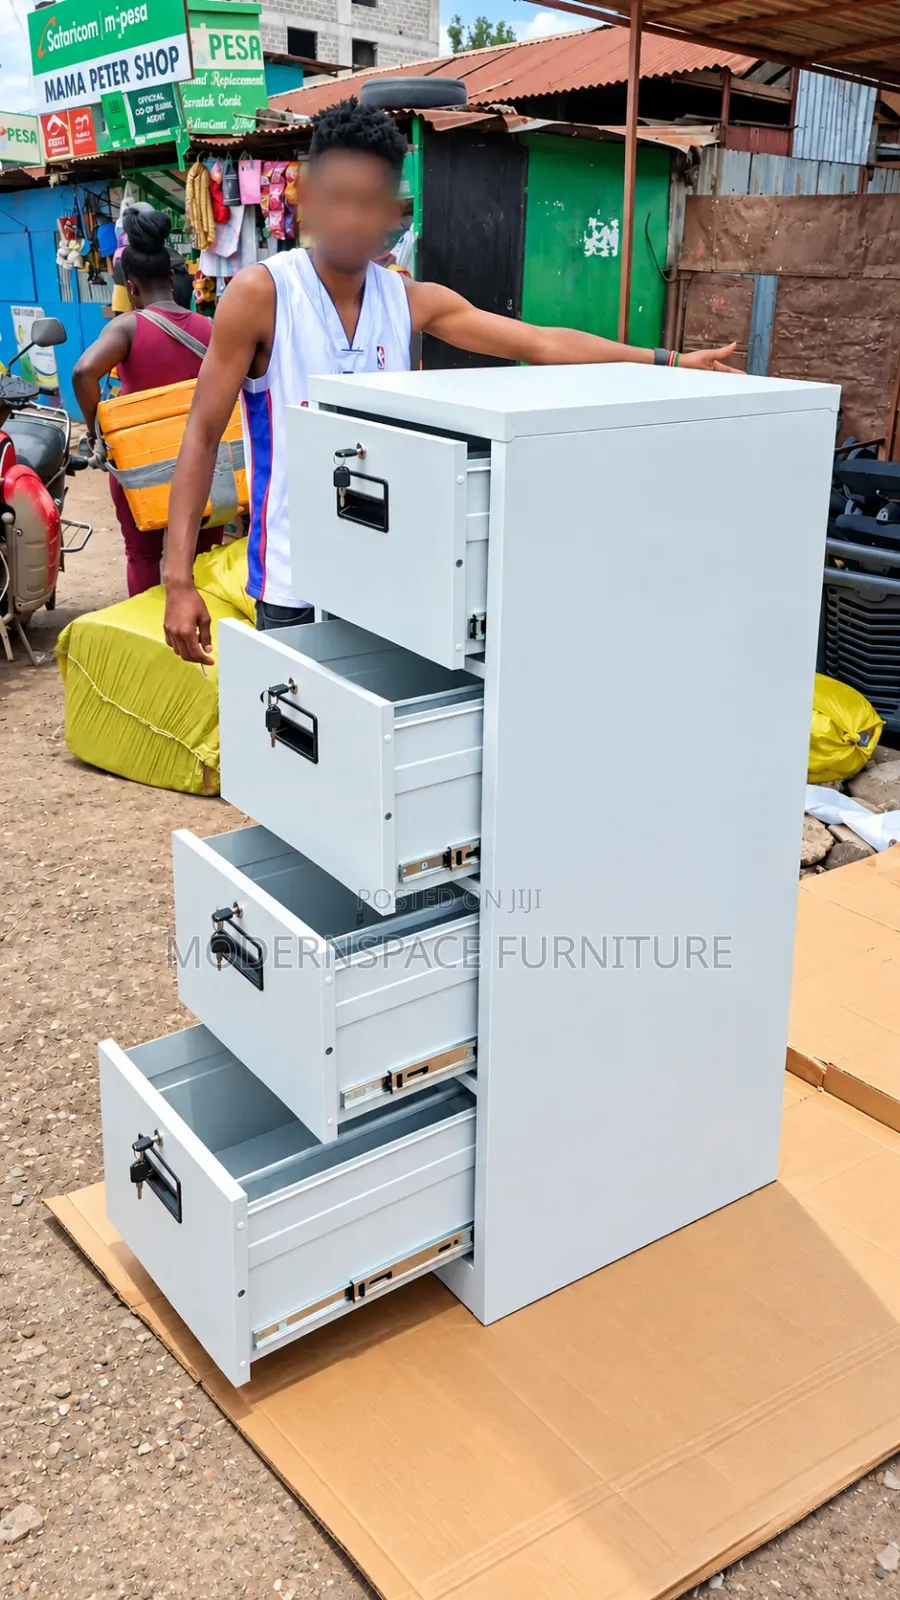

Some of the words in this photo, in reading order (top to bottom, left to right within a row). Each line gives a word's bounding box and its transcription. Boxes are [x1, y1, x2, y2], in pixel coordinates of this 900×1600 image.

[208, 34, 262, 60] PESA
[44, 71, 87, 102] MAMA
[89, 59, 131, 91] PETER
[134, 45, 179, 80] SHOP
[7, 127, 37, 144] PESA
